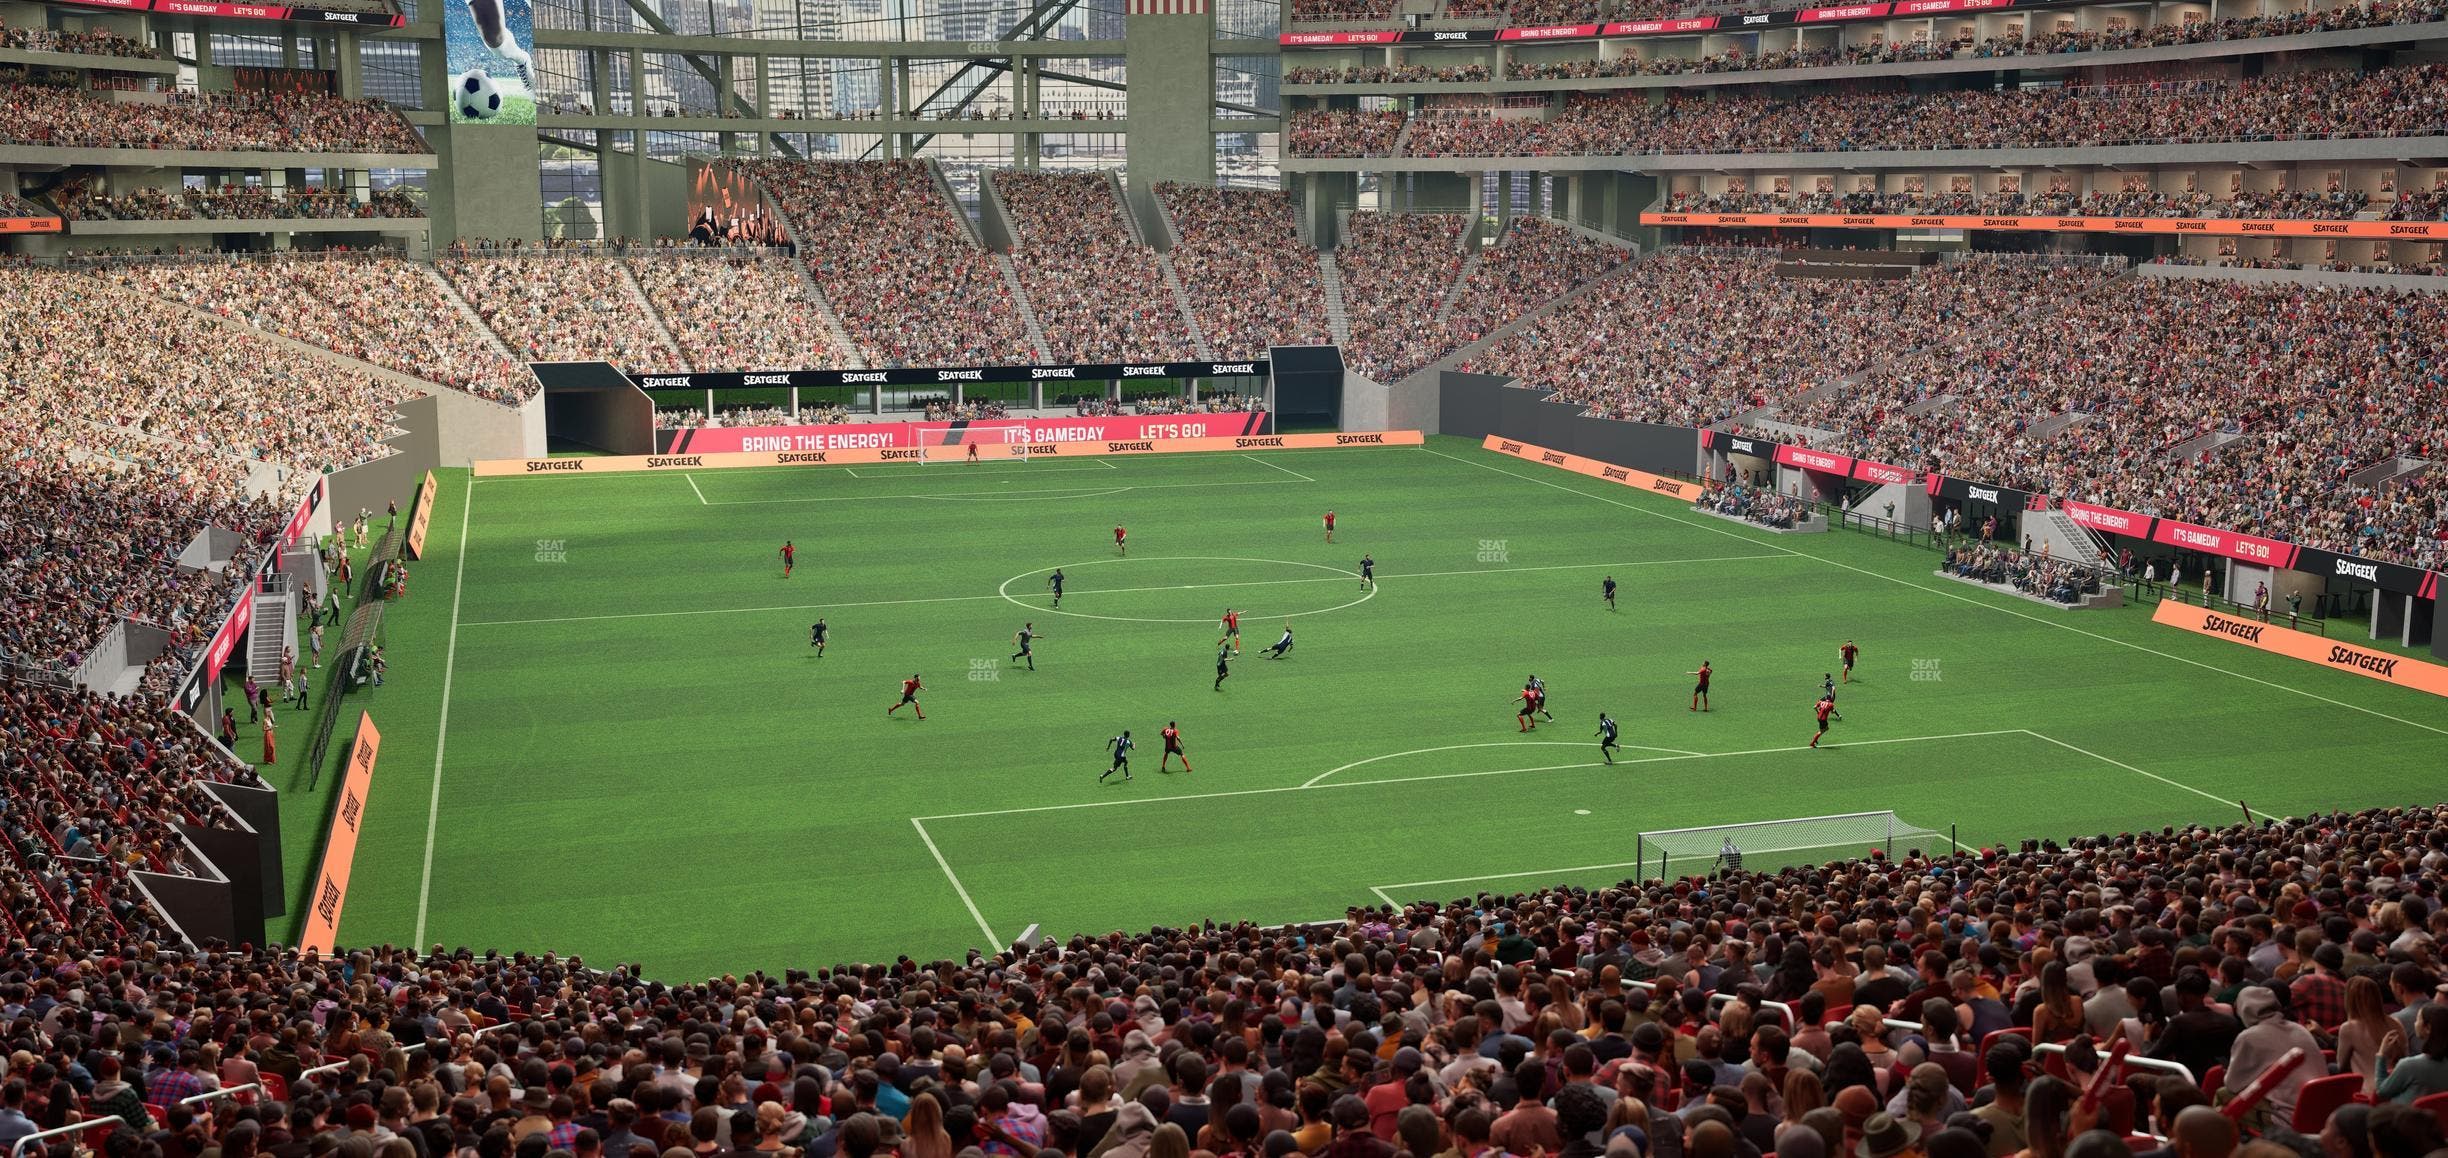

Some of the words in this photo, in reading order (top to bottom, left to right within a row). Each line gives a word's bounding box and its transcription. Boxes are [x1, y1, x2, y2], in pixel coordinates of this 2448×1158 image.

[169, 3, 182, 11] IT'S
[183, 4, 217, 13] GAMEDAY
[233, 7, 252, 15] LET'S
[254, 8, 265, 16] GO!
[1922, 1, 1951, 10] GAMEDAY
[324, 12, 358, 22] SEATGEEK
[1818, 10, 1836, 18] BRING
[1836, 9, 1847, 17] THE
[1848, 7, 1871, 16] ENERGY!
[1743, 14, 1769, 25] SEATGEEK
[1520, 29, 1539, 37] BRING
[1540, 29, 1551, 37] THE
[1552, 27, 1577, 36] ENERGY!
[1633, 23, 1663, 32] GAMEDAY
[1303, 35, 1334, 43] GAMEDAY
[1348, 34, 1365, 42] LET'S
[1366, 34, 1378, 42] GO!
[1434, 31, 1468, 41] SEATGEEK
[2242, 223, 2274, 231] SEATGEEK
[2313, 224, 2348, 233] SEATGEEK
[2391, 226, 2428, 234] SEATGEEK
[1032, 368, 1075, 378] SEATGEEK
[1124, 366, 1165, 376] SEATGEEK
[1213, 364, 1253, 374] SEATGEEK
[744, 375, 790, 385] SEATGEEK
[843, 372, 887, 383] SEATGEEK
[939, 370, 982, 380] SEATGEEK
[643, 377, 690, 387] SEATGEEK
[1003, 427, 1030, 444] IT'S
[1035, 426, 1105, 442] GAMEDAY
[1140, 424, 1178, 439] LET'S
[1182, 423, 1206, 438] GO!
[1337, 434, 1382, 444] SEATGEEK
[742, 436, 791, 452] BRING
[795, 434, 825, 450] THE
[828, 432, 893, 449] ENERGY!
[1109, 442, 1153, 452] SEATGEEK
[1236, 438, 1283, 447] SEATGEEK
[1500, 441, 1521, 454] SEATGEEK
[1732, 439, 1752, 453] SEATGEEK
[648, 456, 702, 467] SEATGEEK
[778, 452, 826, 463] SEATGEEK
[1542, 452, 1566, 465] SEATGEEK
[527, 460, 582, 471] SEATGEEK
[1603, 467, 1629, 482] SEATGEEK
[1654, 479, 1682, 495] SEATGEEK
[1969, 486, 1998, 503] SEATGEEK
[2090, 511, 2102, 524] THE
[2103, 514, 2129, 530] ENERGY!
[2173, 528, 2186, 541] IT'S
[2187, 531, 2220, 548] GAMEDAY
[2236, 541, 2256, 555] LET'S
[2256, 545, 2270, 558] GO!
[2335, 559, 2377, 582] SEATGEEK
[2203, 615, 2263, 643] SEATGEEK
[2328, 646, 2398, 677] SEATGEEK
[342, 787, 361, 833] SEATGEEK
[318, 873, 340, 930] SEATGEEK
